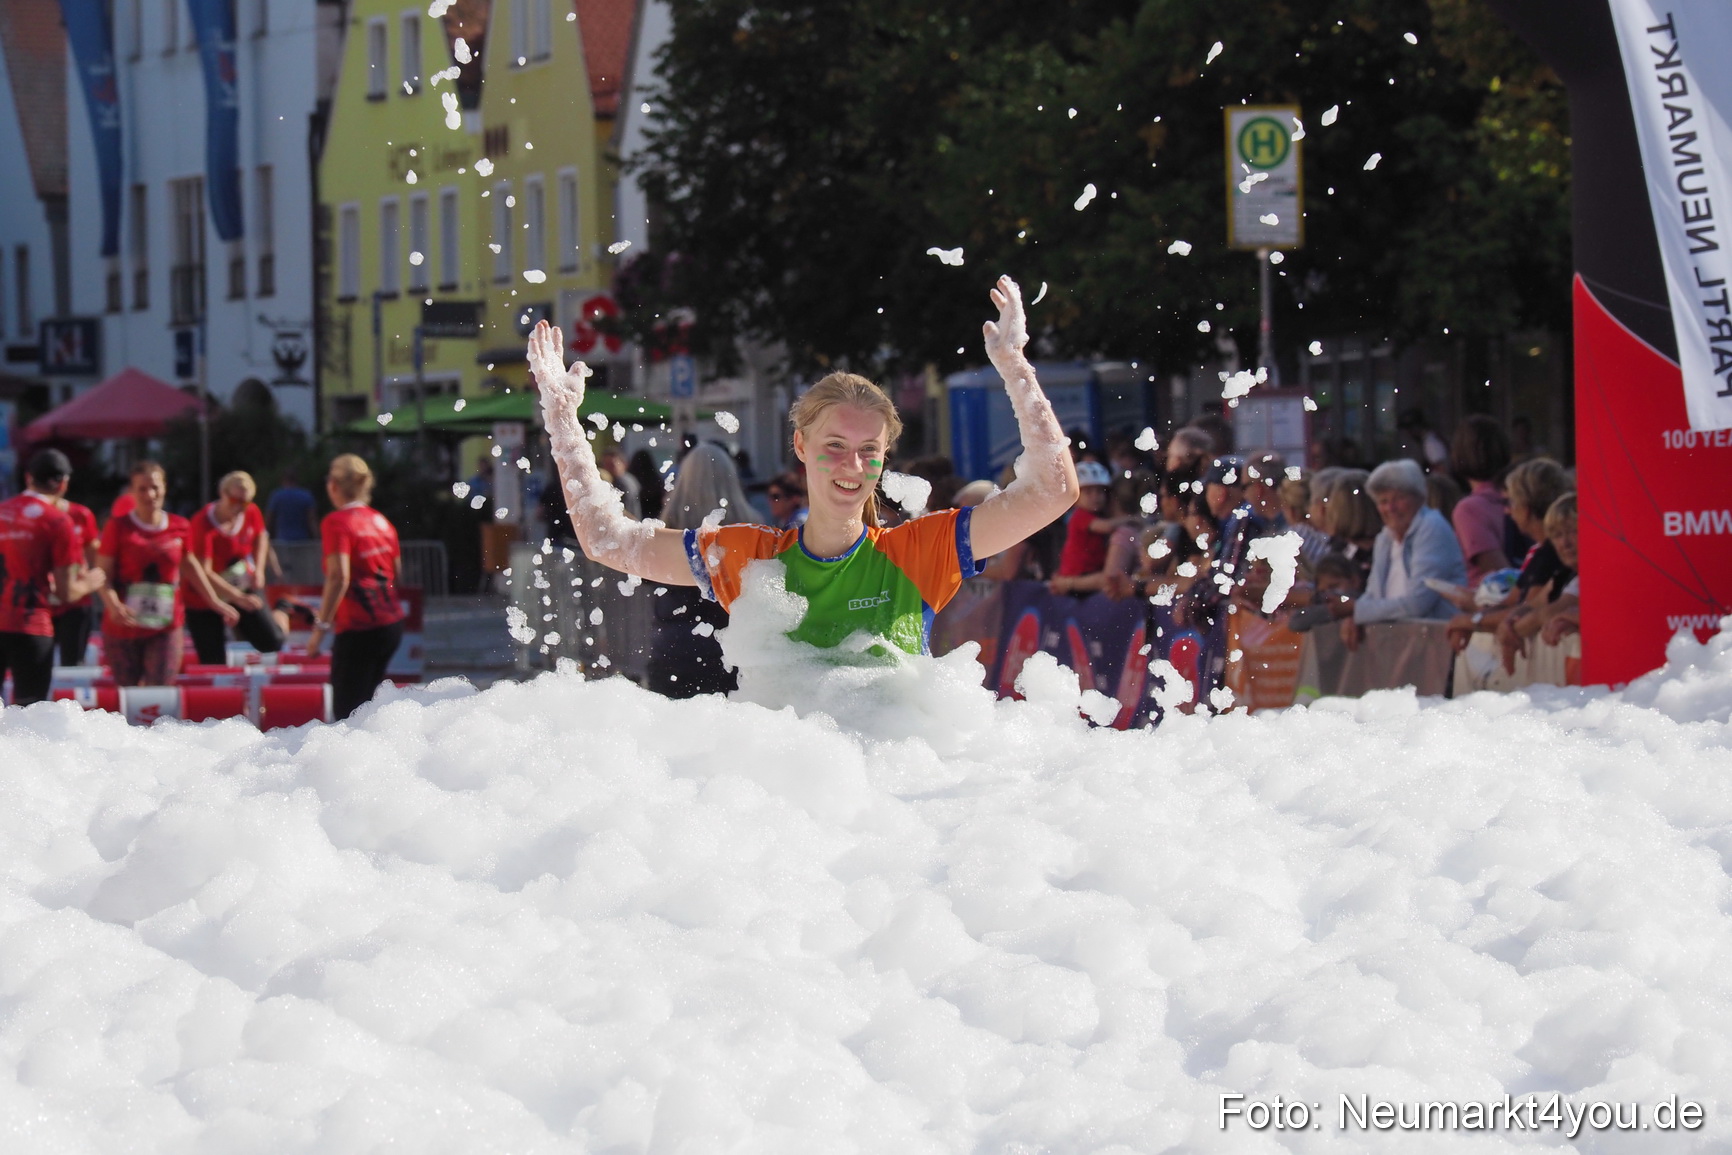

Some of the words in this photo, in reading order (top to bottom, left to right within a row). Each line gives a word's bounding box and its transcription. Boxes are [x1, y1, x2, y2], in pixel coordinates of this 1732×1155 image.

[1251, 129, 1275, 158] H
[1661, 429, 1697, 449] 100
[1663, 509, 1732, 536] BMW
